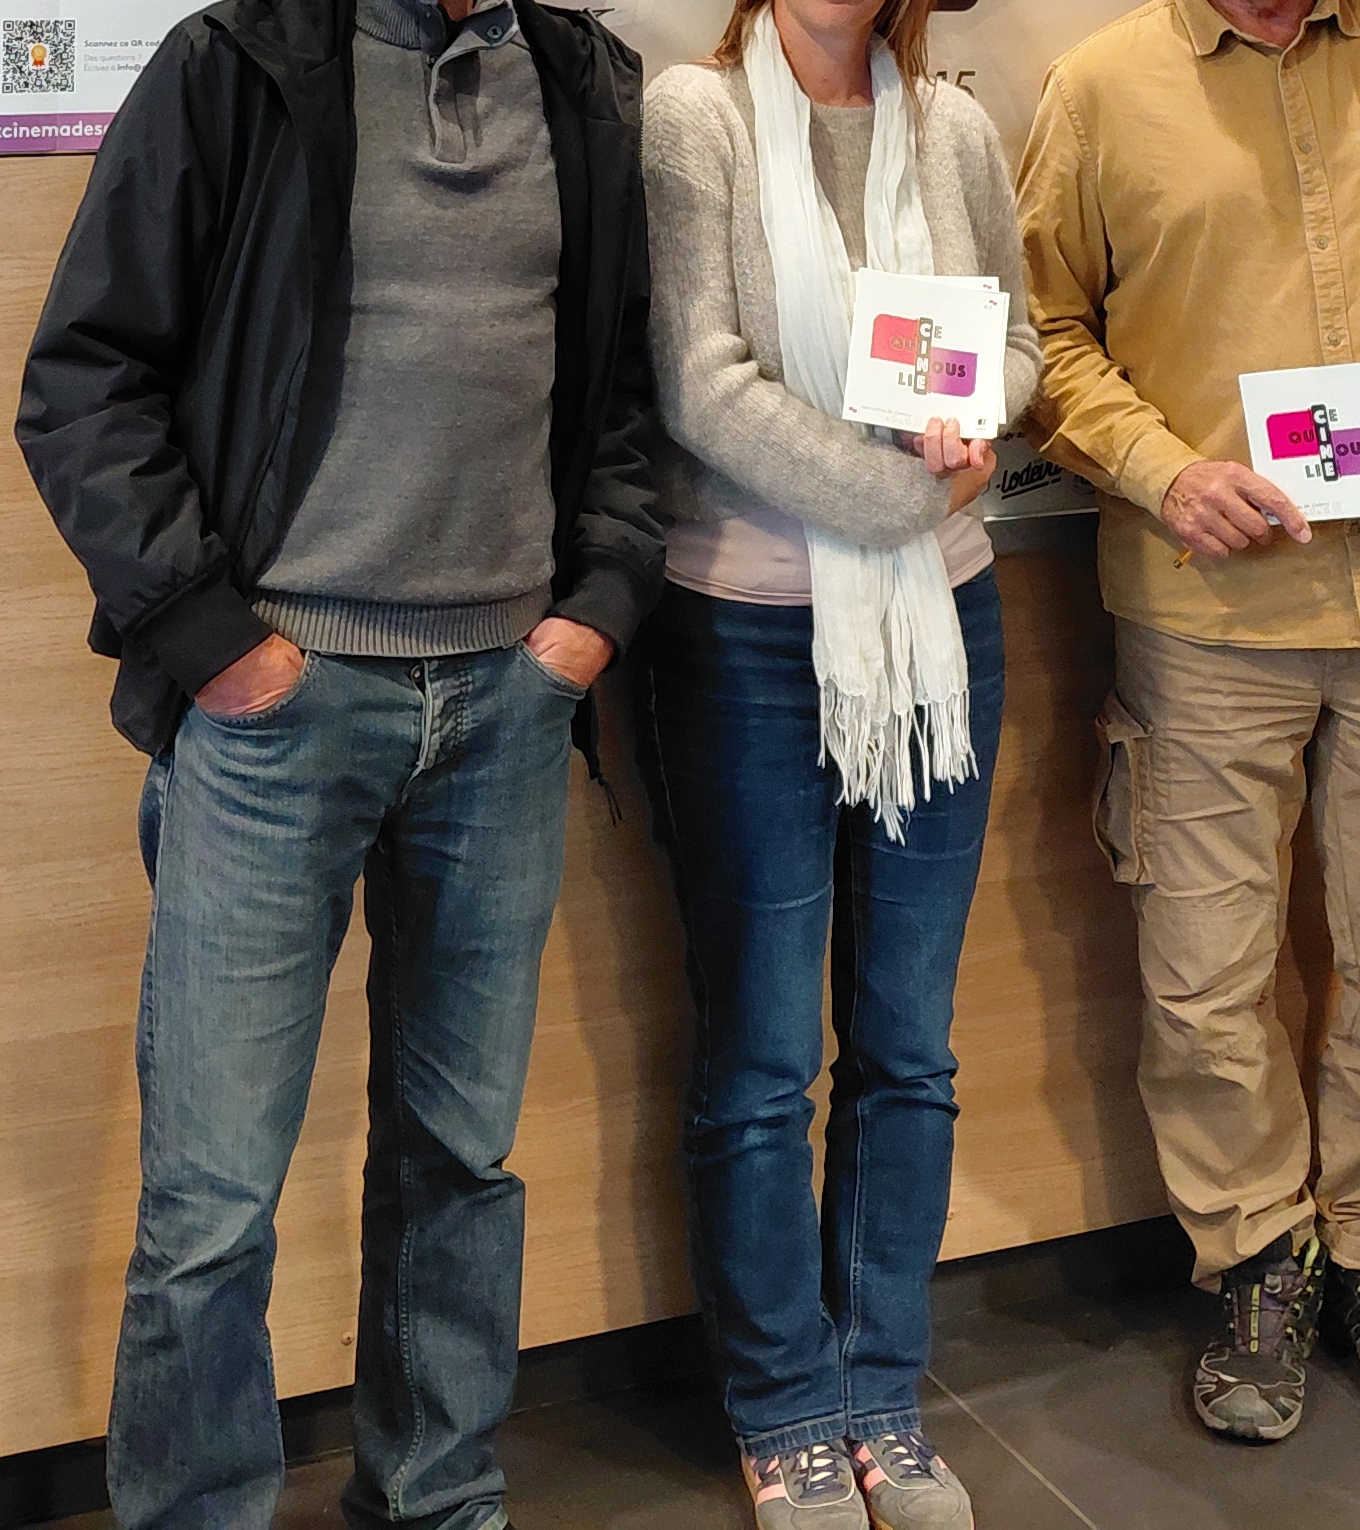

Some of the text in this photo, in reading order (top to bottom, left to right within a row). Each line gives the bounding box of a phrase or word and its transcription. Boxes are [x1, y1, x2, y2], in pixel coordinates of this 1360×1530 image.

[84, 39, 118, 47] Scannez
[130, 39, 144, 47] QR
[145, 39, 160, 47] cod
[117, 63, 145, 72] info@
